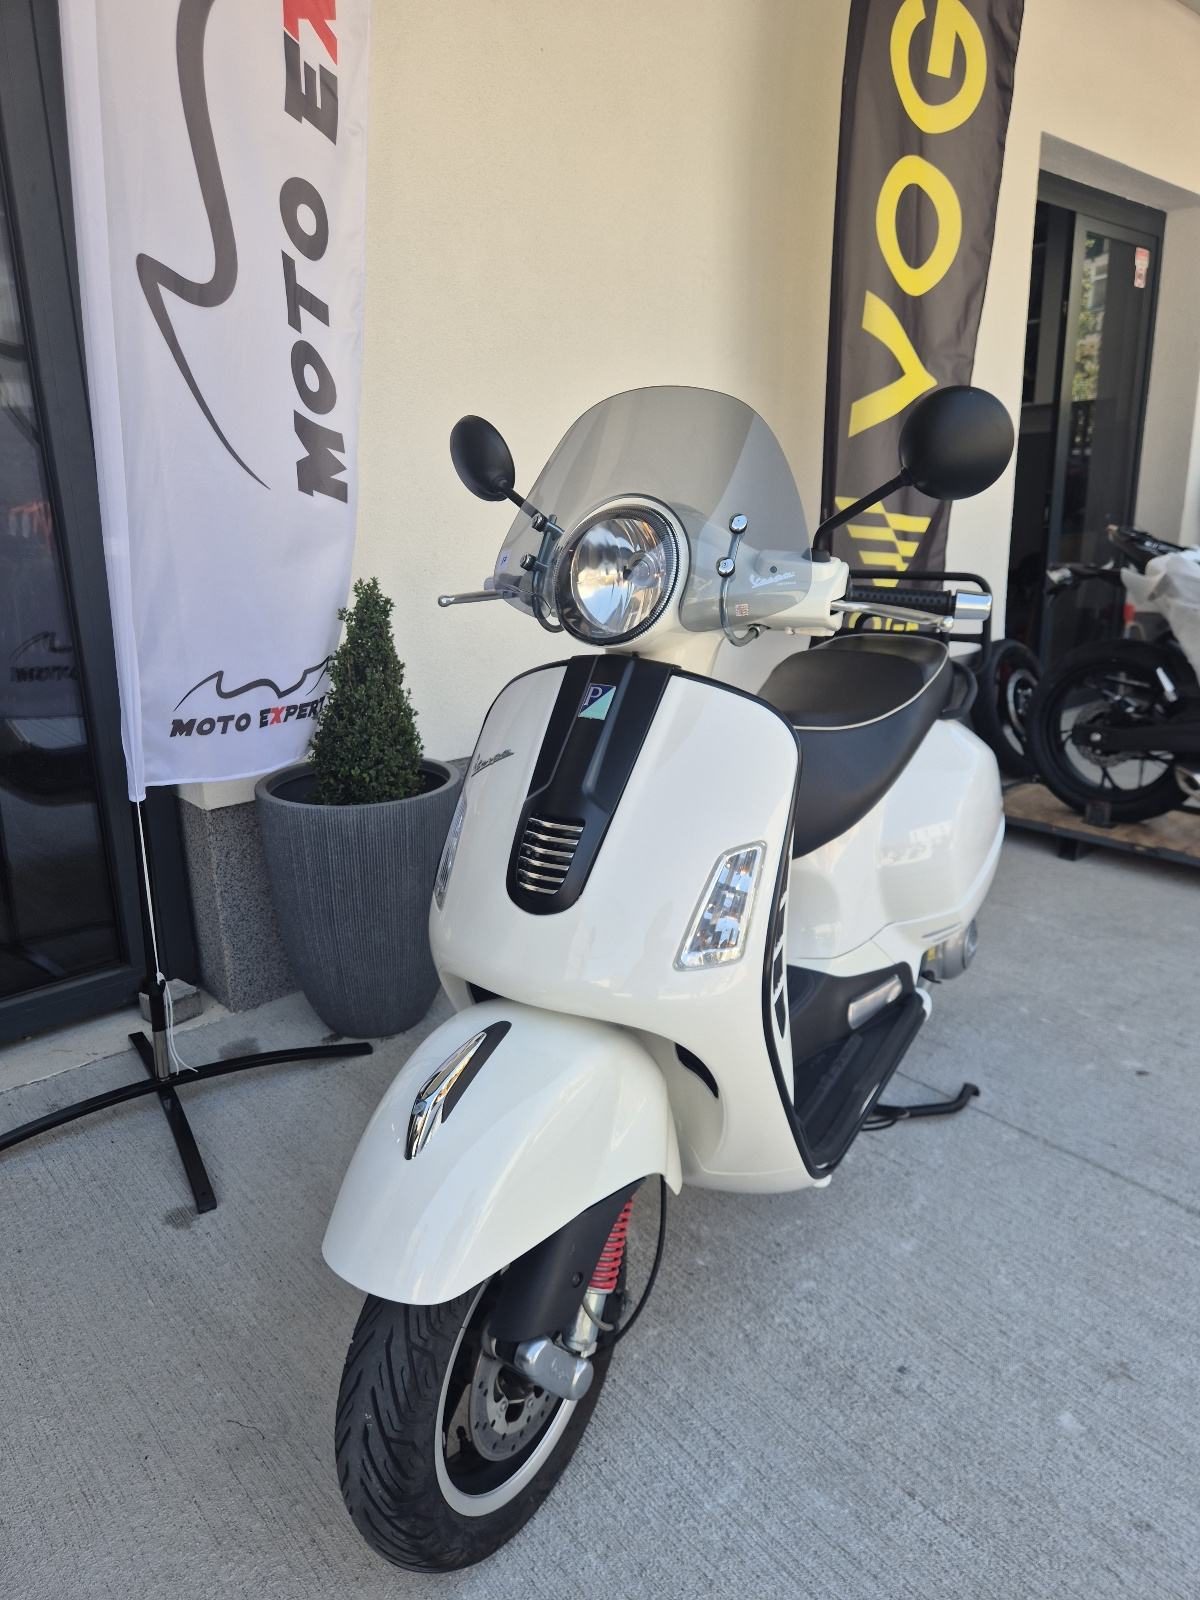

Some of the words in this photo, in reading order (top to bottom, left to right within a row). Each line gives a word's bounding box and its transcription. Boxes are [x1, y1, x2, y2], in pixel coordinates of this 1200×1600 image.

[279, 176, 348, 504] MOTO
[169, 712, 252, 738] MOTO
[259, 695, 326, 729] EXPERT
